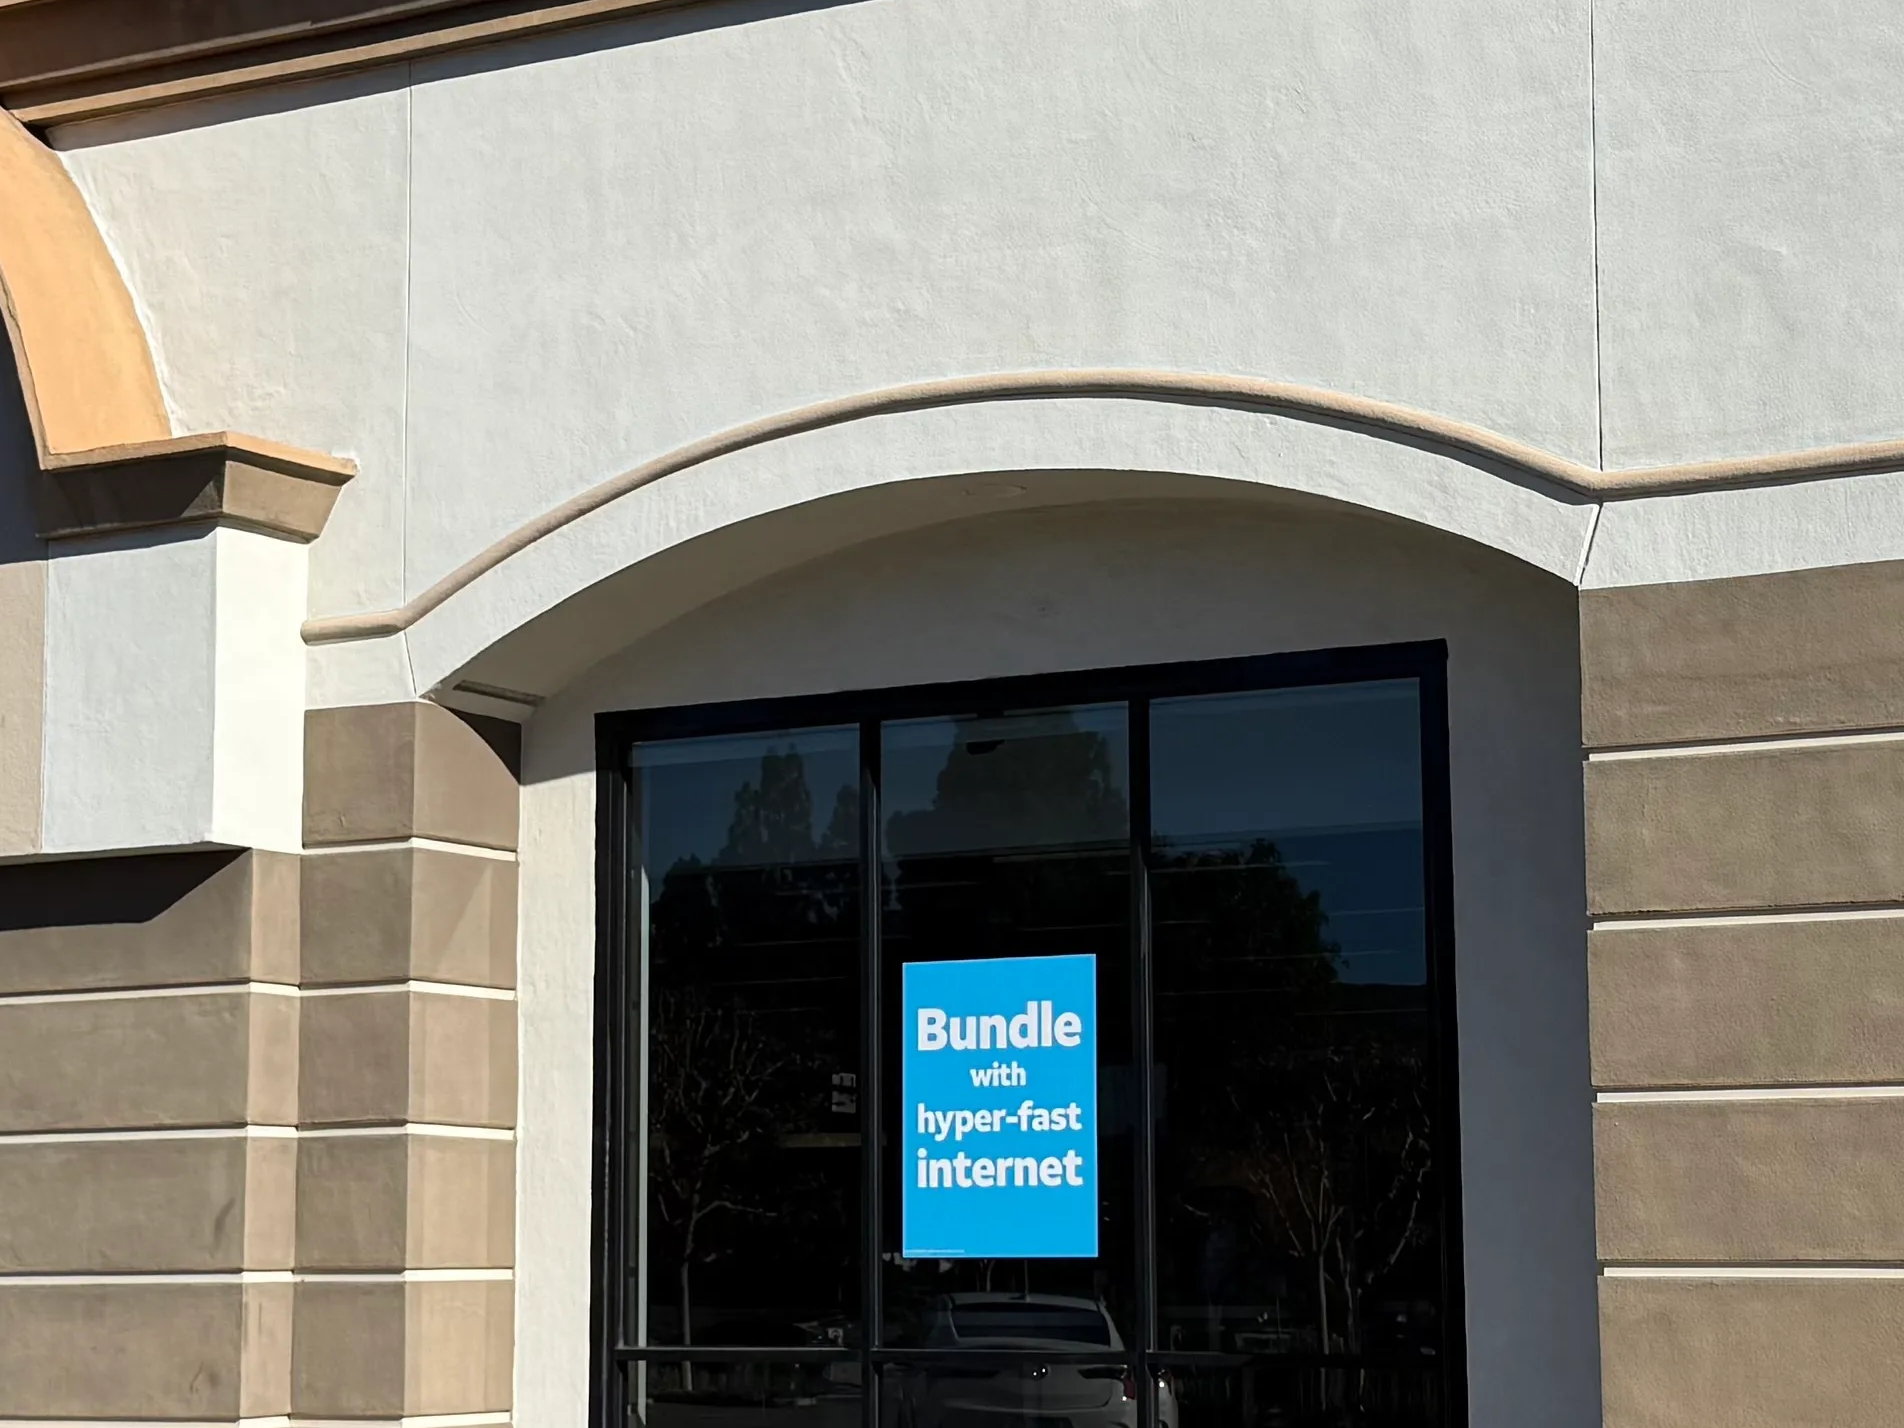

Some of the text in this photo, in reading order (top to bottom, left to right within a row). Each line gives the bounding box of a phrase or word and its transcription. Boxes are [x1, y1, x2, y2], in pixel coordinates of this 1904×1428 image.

[917, 1000, 1083, 1052] Bundle
[969, 1061, 1027, 1087] with
[916, 1100, 1083, 1142] hyper-fast
[917, 1147, 1084, 1188] internet
